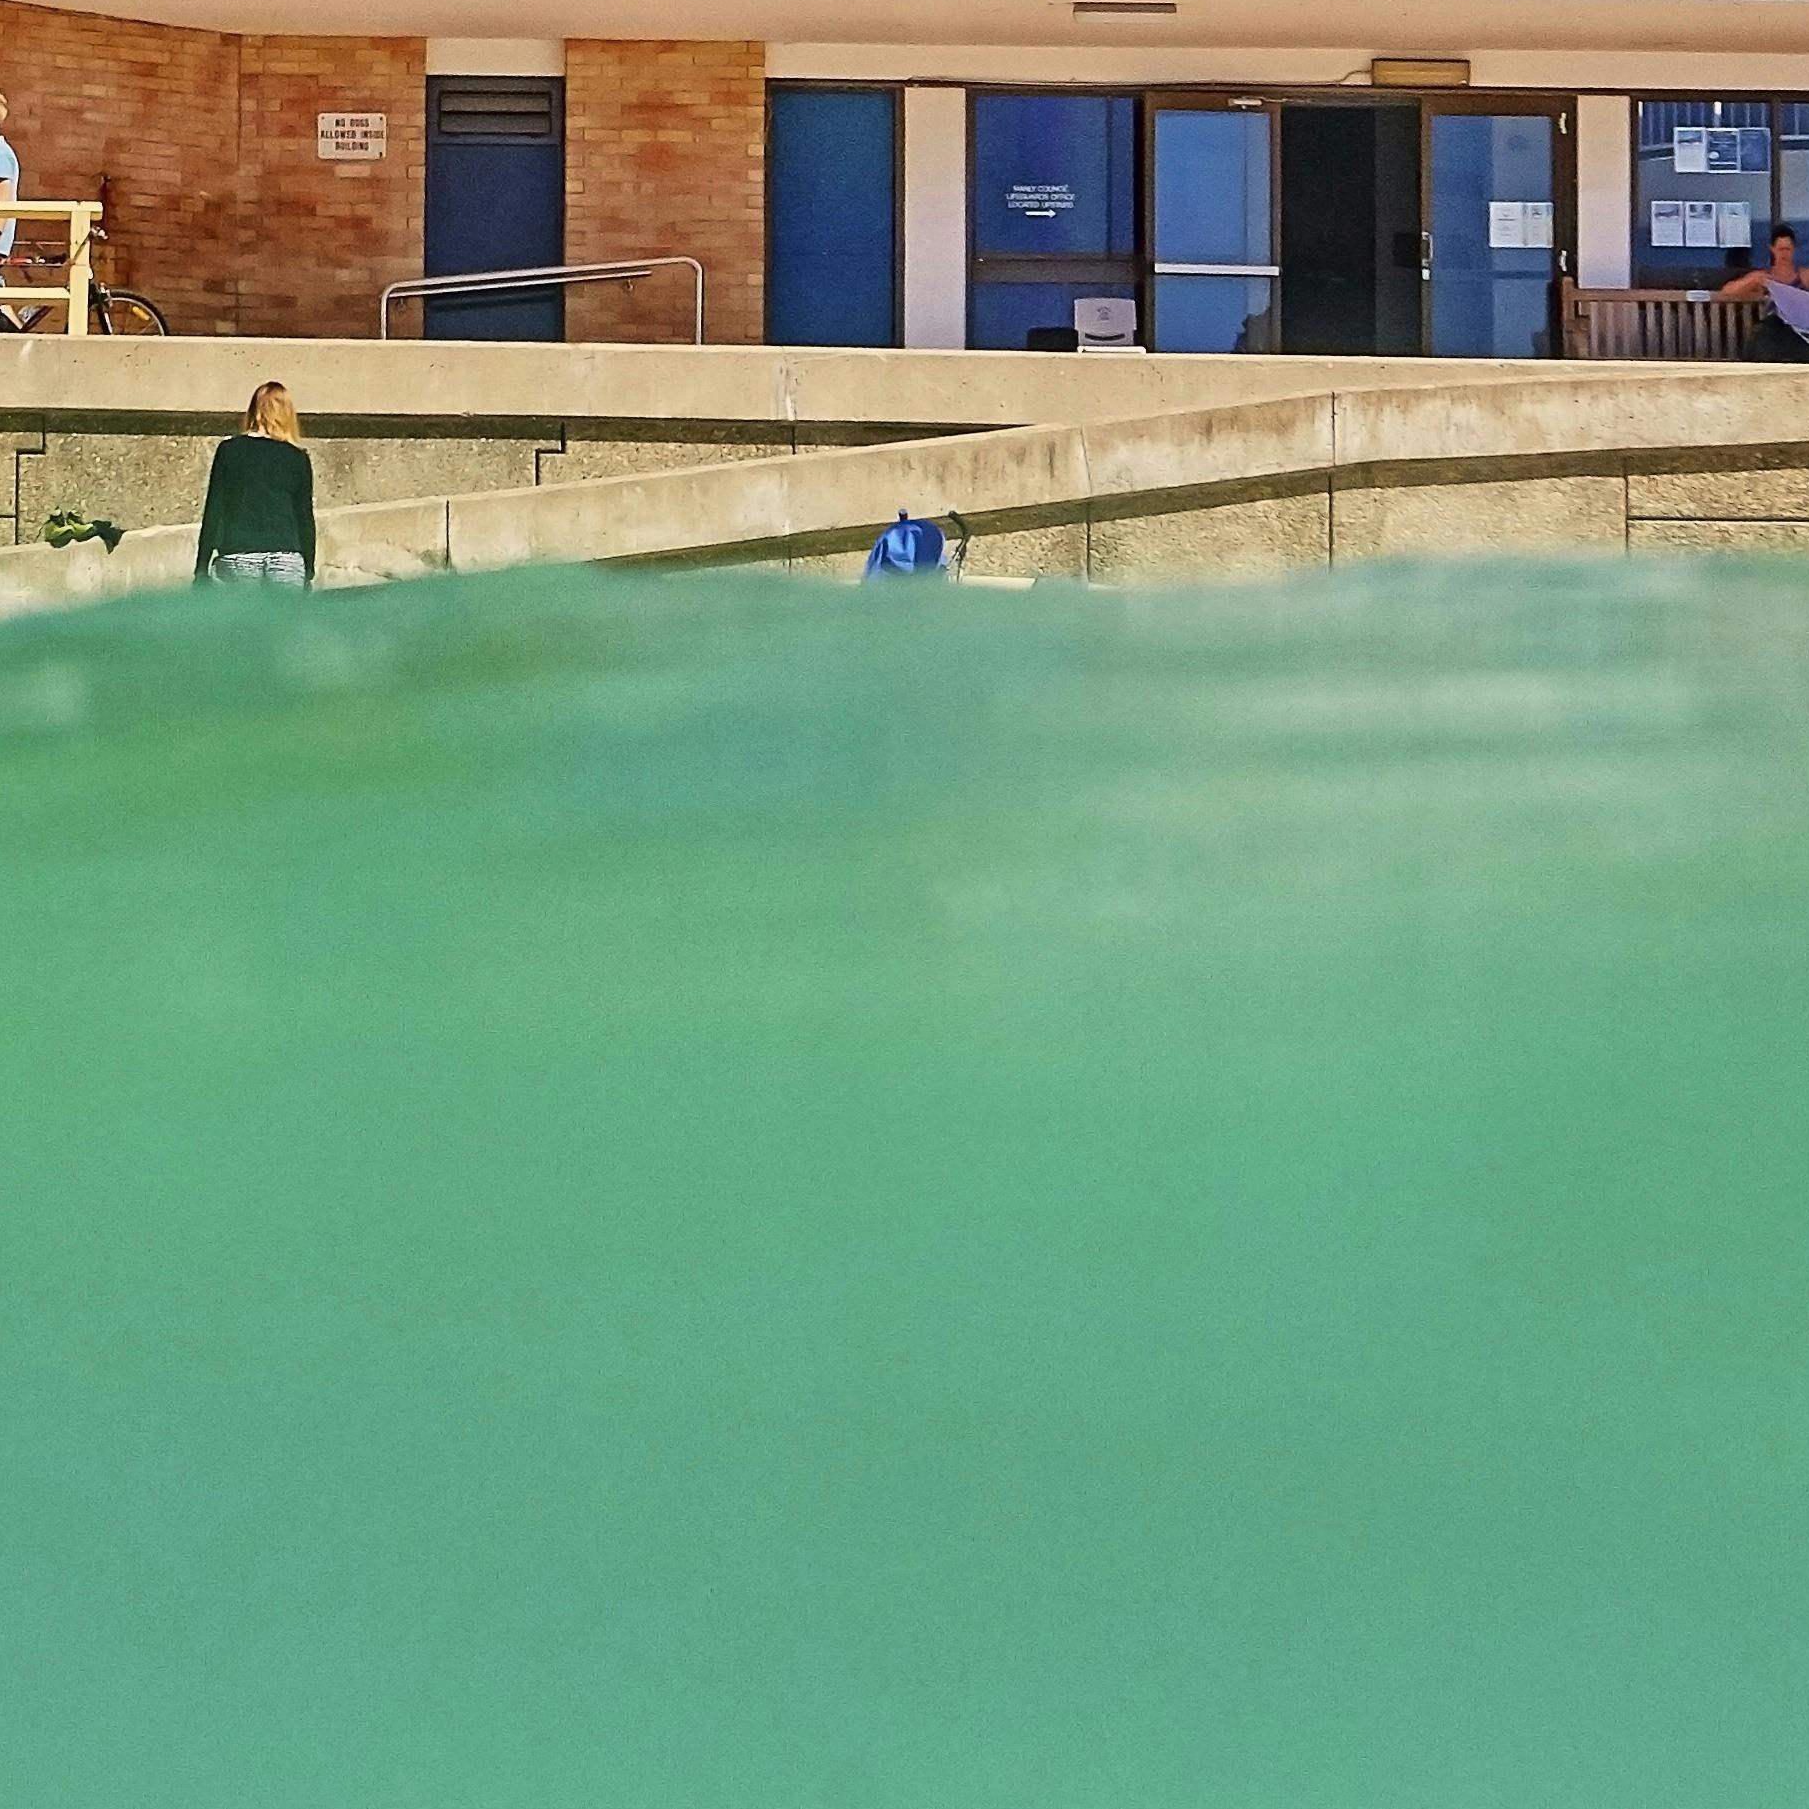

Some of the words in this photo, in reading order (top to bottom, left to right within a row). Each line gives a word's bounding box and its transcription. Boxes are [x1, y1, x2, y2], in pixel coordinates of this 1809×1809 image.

[334, 117, 346, 128] NO
[349, 117, 370, 128] DOGS
[320, 130, 357, 139] ALLOWED
[360, 130, 384, 139] INSIDE
[334, 141, 370, 151] BUILDING
